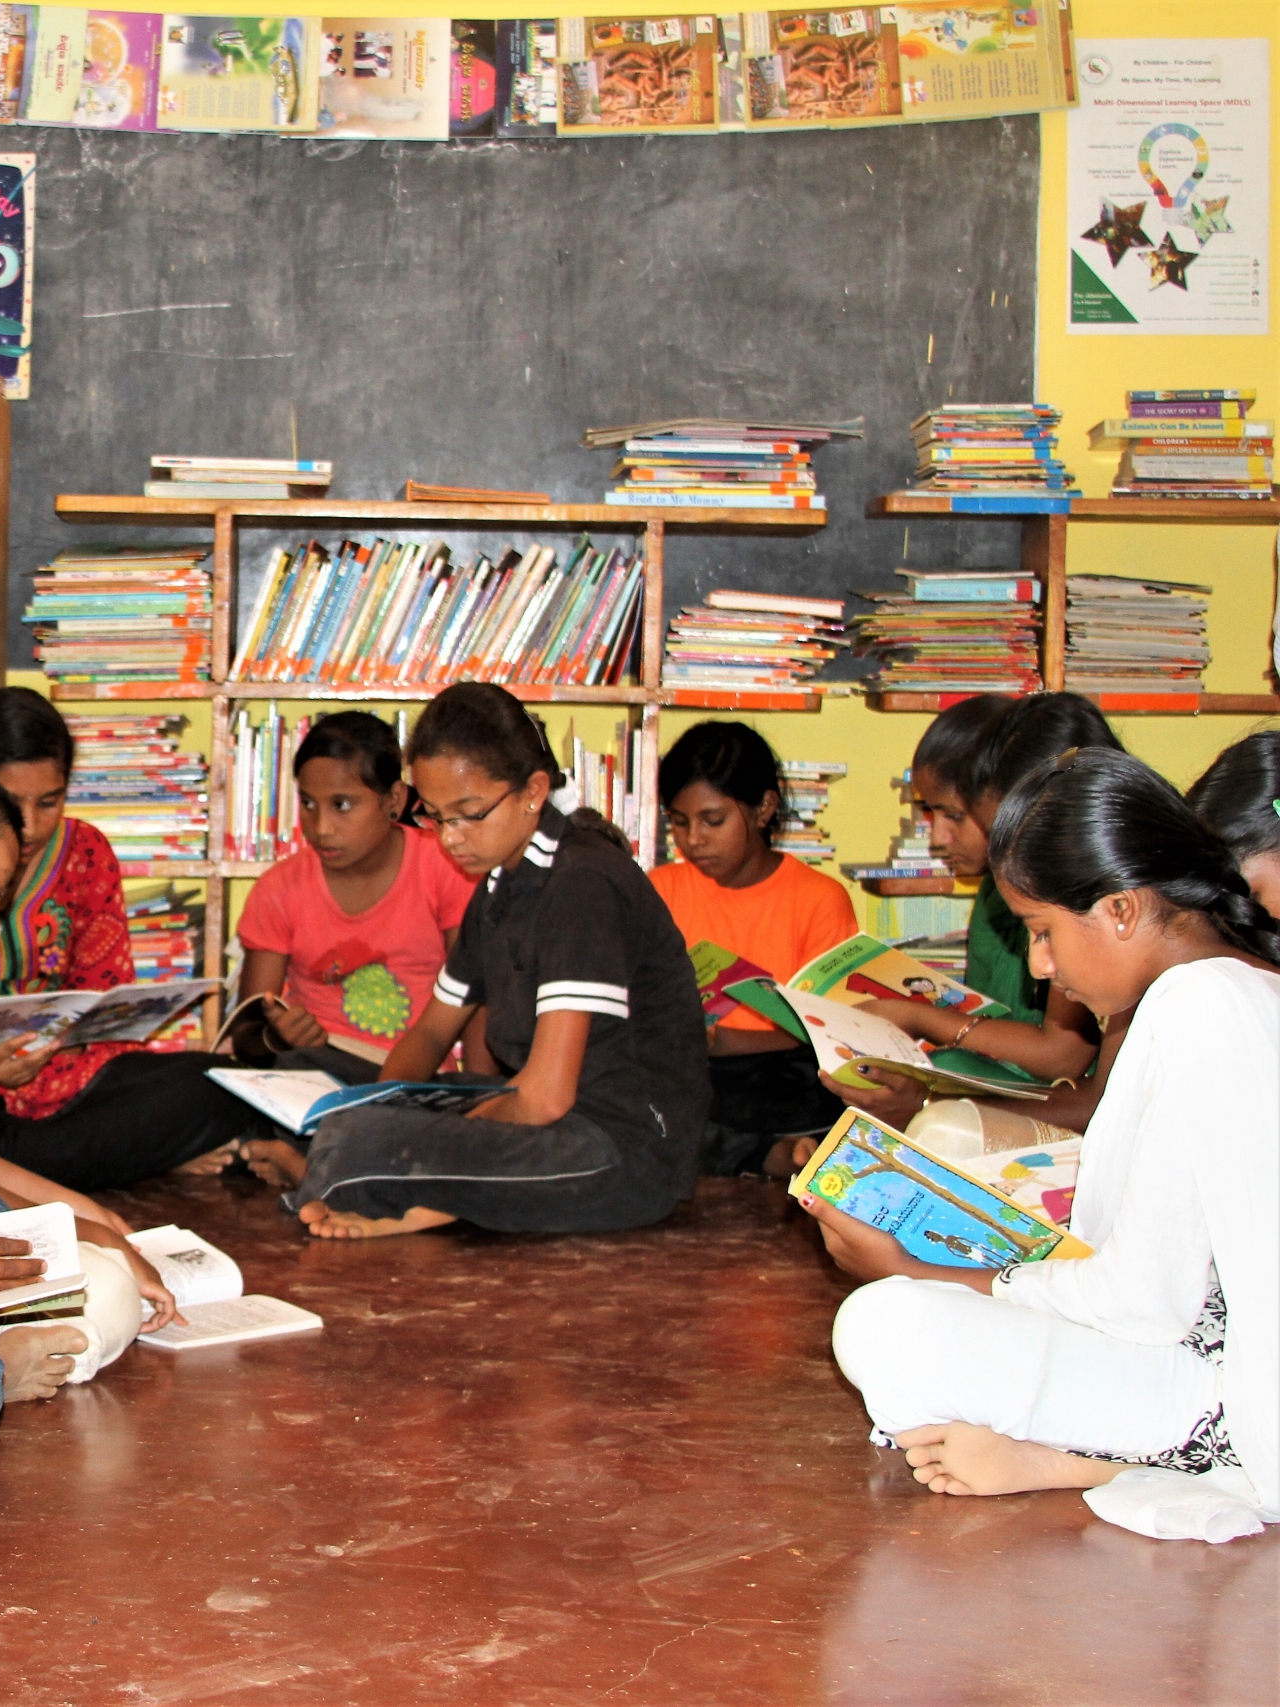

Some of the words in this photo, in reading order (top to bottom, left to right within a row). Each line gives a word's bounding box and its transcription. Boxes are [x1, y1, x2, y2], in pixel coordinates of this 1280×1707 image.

[1094, 99, 1162, 107] Multi-Dimensional
[1165, 99, 1197, 108] Learning
[1200, 99, 1221, 108] Space
[1223, 99, 1251, 107] (MDLS)
[628, 494, 652, 505] Read
[656, 495, 666, 505] to
[670, 495, 685, 505] Me
[689, 496, 725, 507] Mommy
[868, 869, 898, 878] RUSSELL
[869, 1203, 889, 1226] ಮರ
